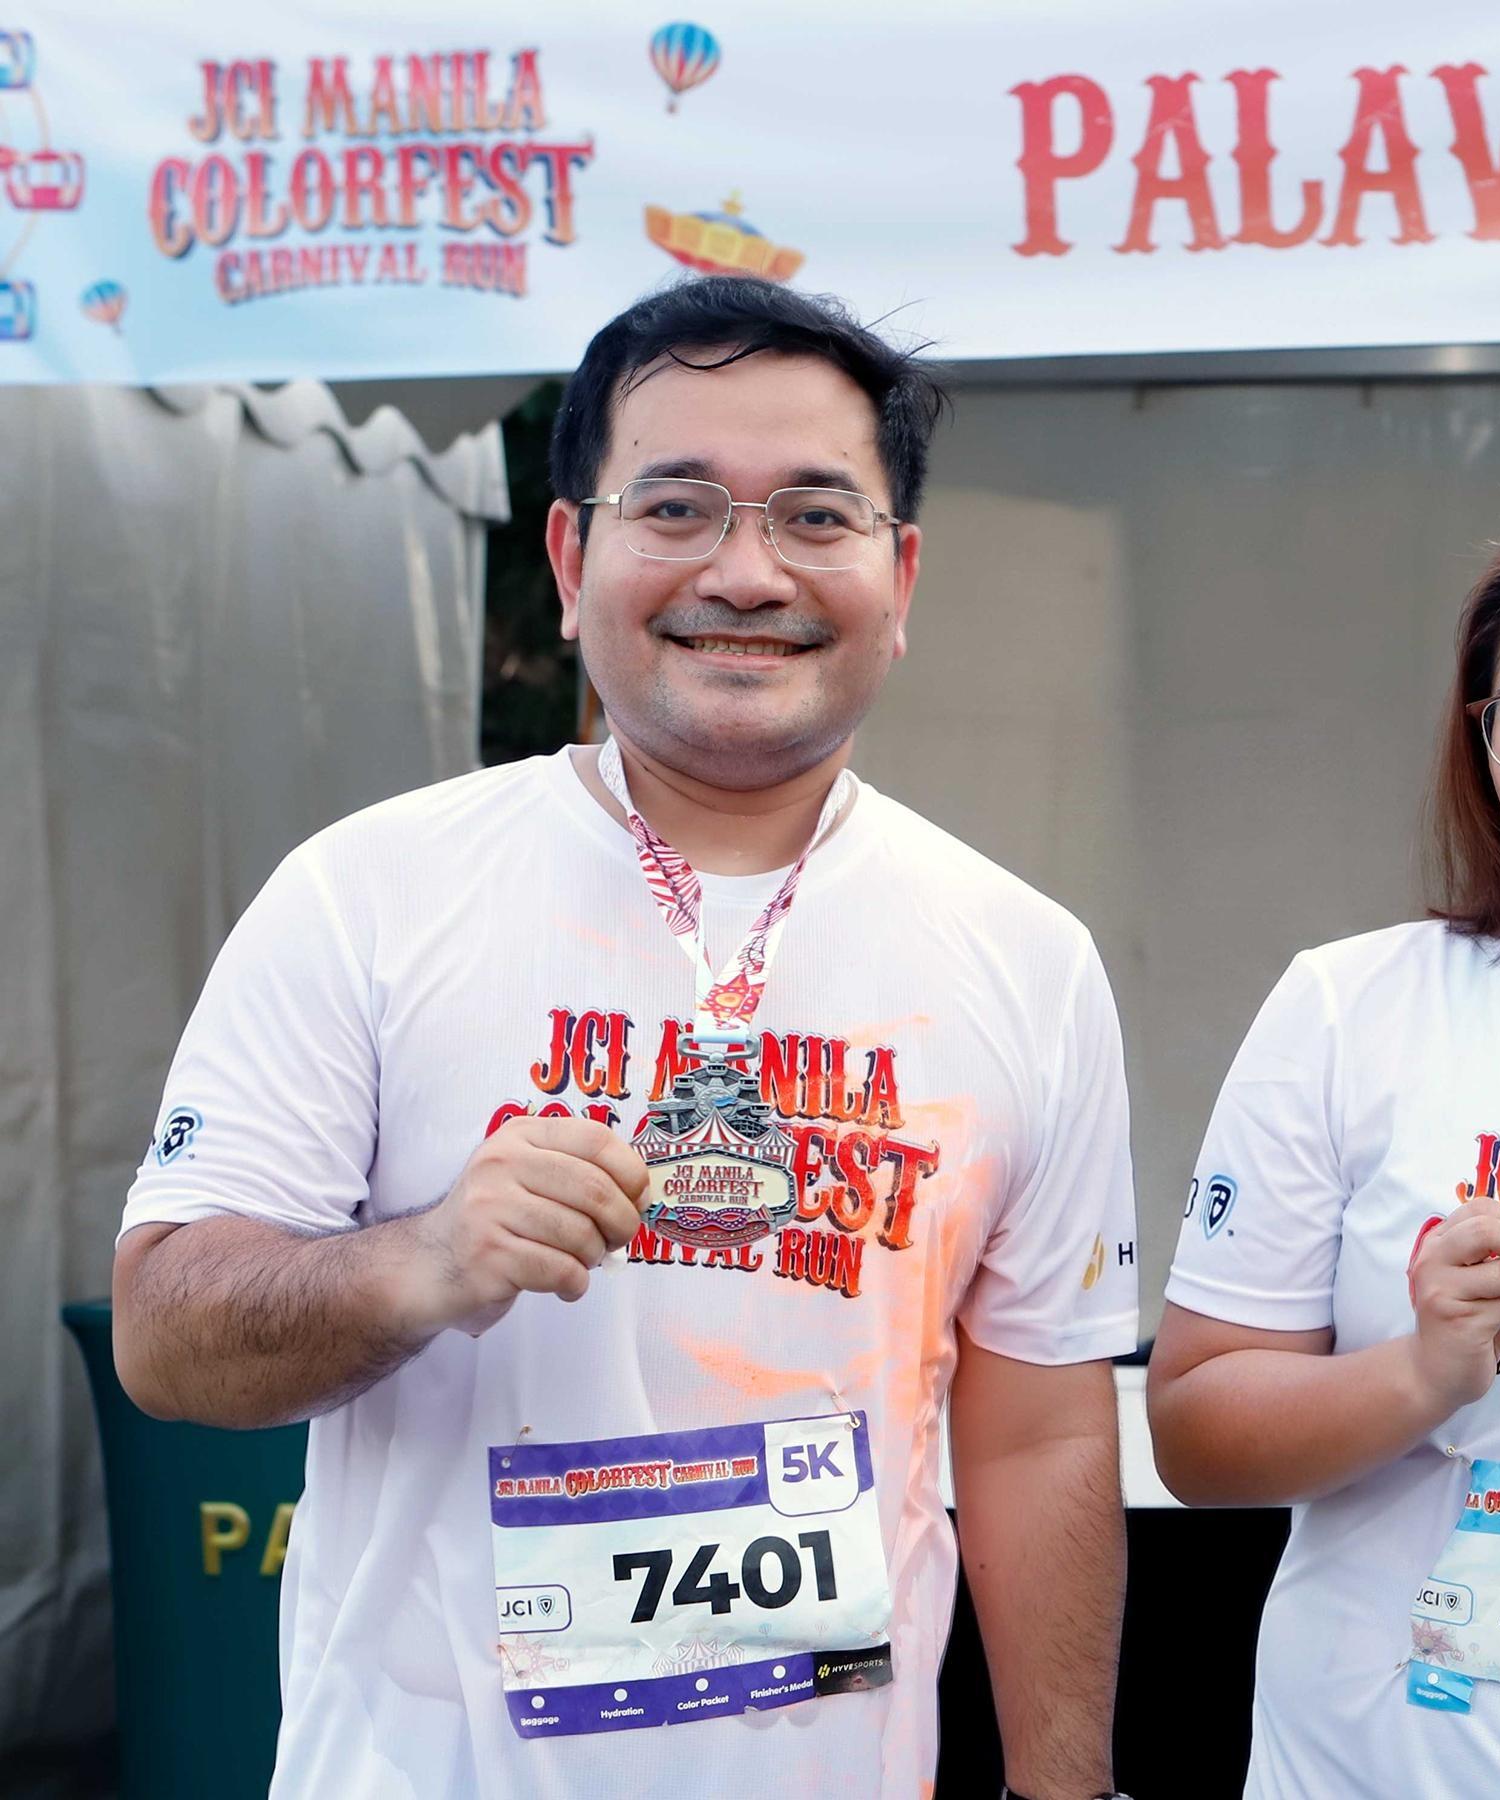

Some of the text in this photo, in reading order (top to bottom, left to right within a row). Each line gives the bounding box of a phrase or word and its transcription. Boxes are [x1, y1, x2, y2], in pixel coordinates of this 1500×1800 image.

[188, 50, 547, 142] JCI MANILA
[148, 135, 594, 259] COLORFEST
[214, 244, 529, 305] CARNIVAL RUN
[530, 1005, 634, 1101] JCI
[664, 1179, 764, 1199] COLORFEST
[673, 1165, 755, 1180] JCI MANILA
[678, 1194, 749, 1205] CARNIVAL RUN
[773, 1228, 867, 1298] RUN
[565, 1460, 673, 1498] COLORFEST
[781, 1441, 843, 1484] 5K
[612, 1529, 838, 1624] 7401
[1416, 1588, 1439, 1606] JCI
[501, 1600, 532, 1617] JCI
[600, 1706, 644, 1720] Hydration
[677, 1699, 701, 1711] Color
[750, 1685, 790, 1699] Finisher's
[790, 1678, 814, 1692] Medal
